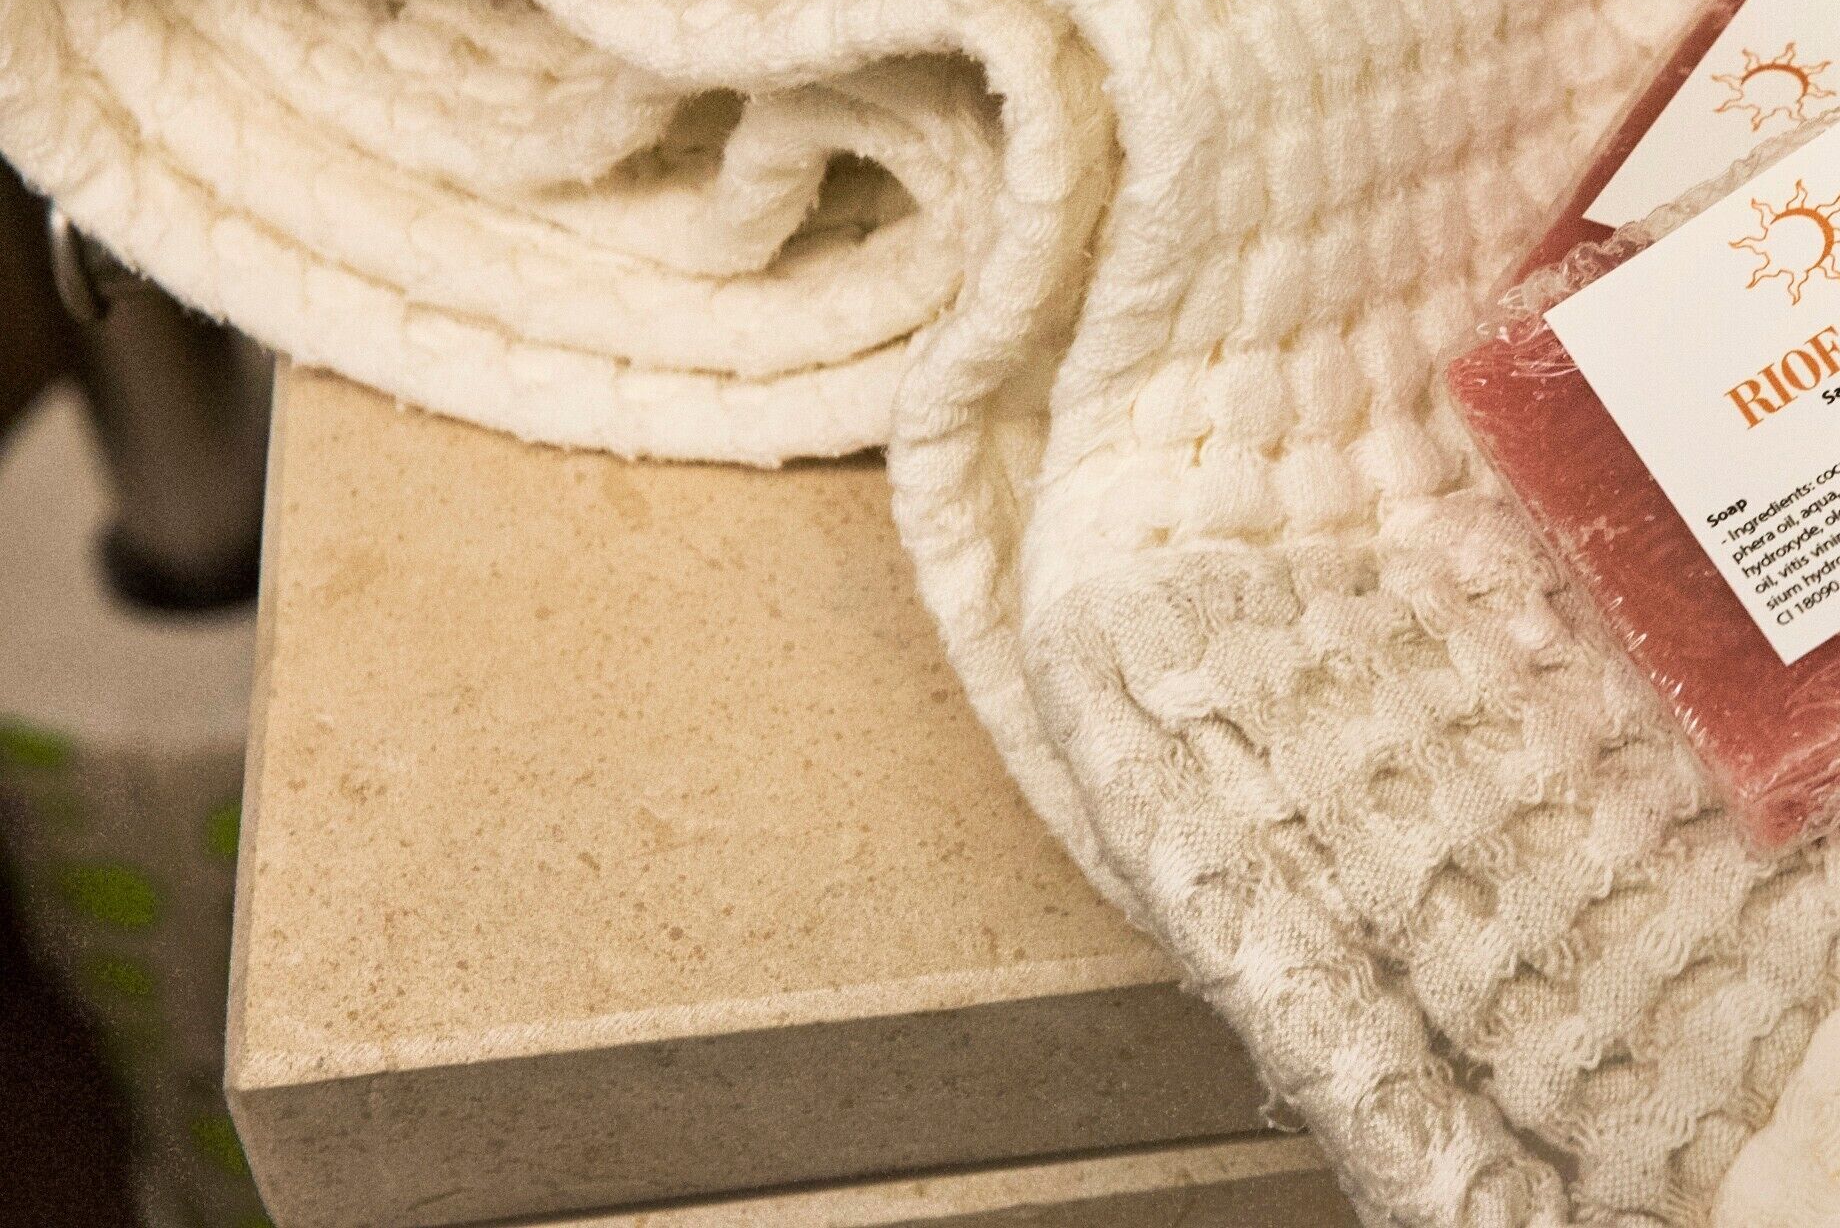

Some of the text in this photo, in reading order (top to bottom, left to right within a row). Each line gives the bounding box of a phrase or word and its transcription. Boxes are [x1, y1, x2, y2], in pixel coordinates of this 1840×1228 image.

[1707, 498, 1747, 528] Soap
[1728, 483, 1815, 541] Ingredients:
[1732, 532, 1776, 565] phera
[1777, 515, 1800, 534] oil,
[1801, 491, 1840, 519] aqua,
[1742, 525, 1824, 579] hydroxyde,
[1755, 575, 1778, 594] oil,
[1778, 555, 1810, 578] vitis
[1766, 584, 1802, 611] sium
[1776, 580, 1840, 626] CI 18090
